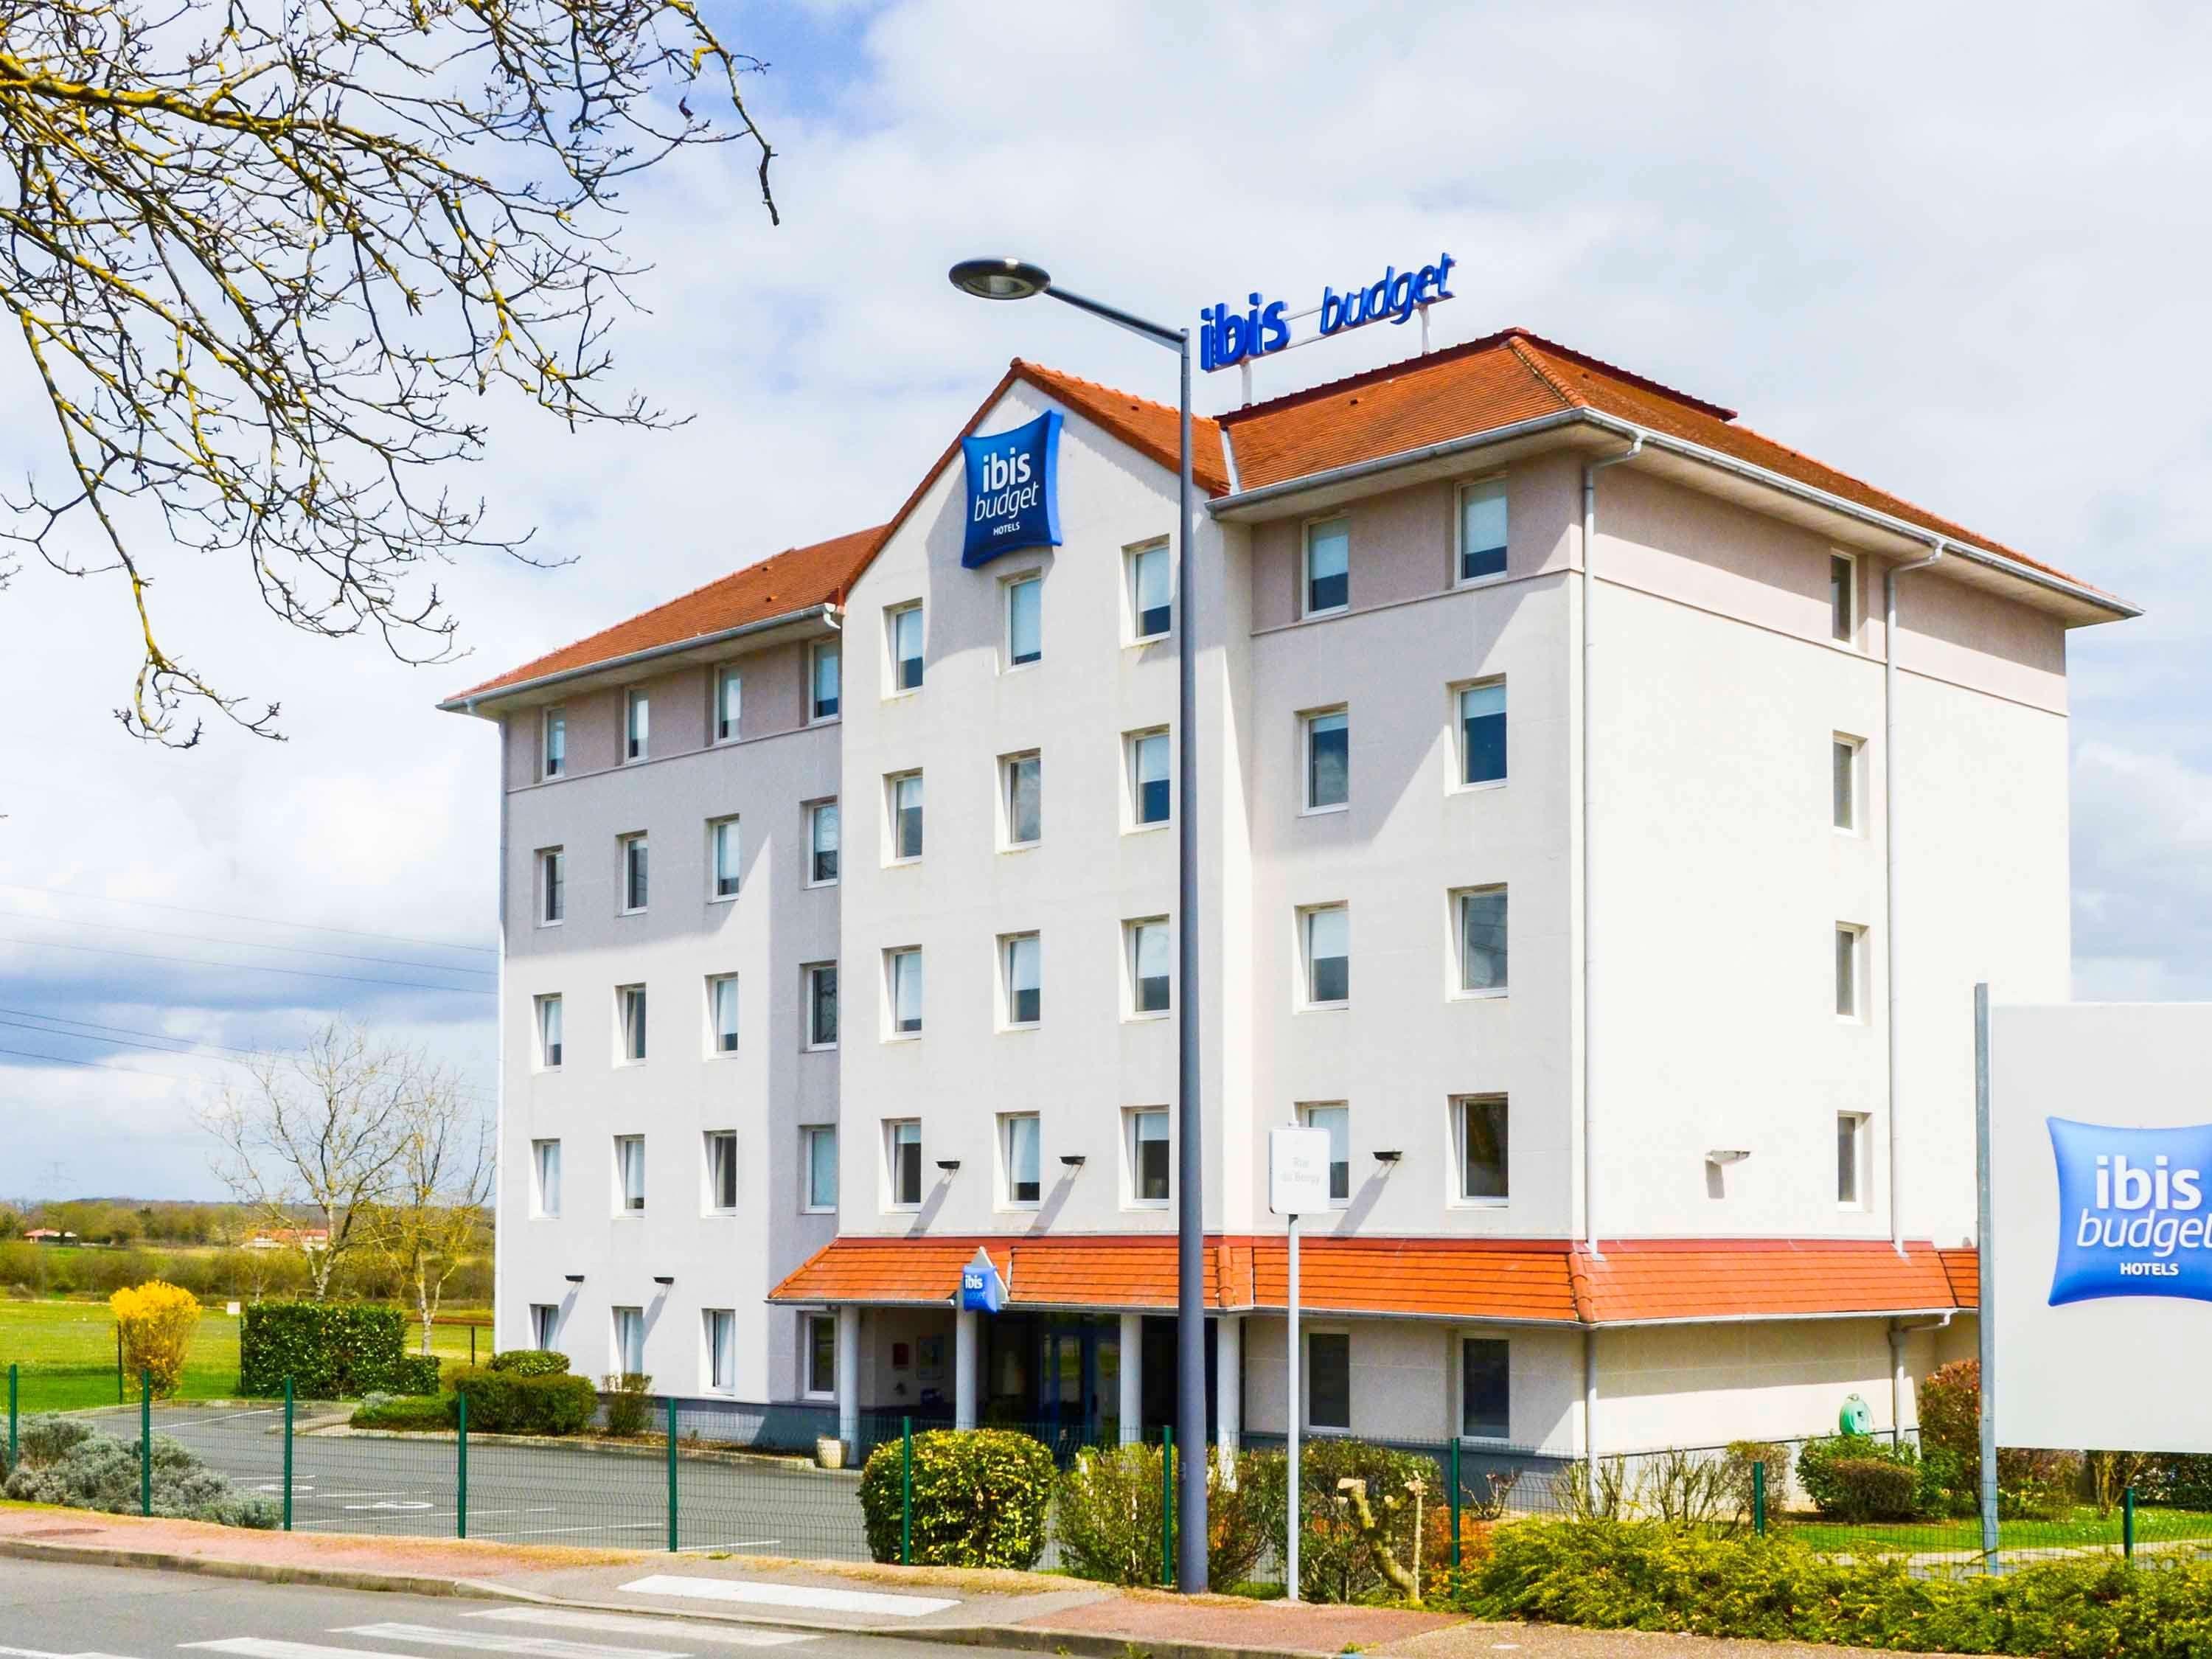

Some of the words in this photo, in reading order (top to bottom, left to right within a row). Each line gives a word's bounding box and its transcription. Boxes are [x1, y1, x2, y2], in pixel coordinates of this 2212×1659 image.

[1200, 292, 1290, 372] ibis
[1320, 252, 1456, 335] budget
[983, 447, 1032, 493] ibis
[974, 481, 1039, 521] budget
[993, 522, 1020, 535] HOTELS
[2096, 1155, 2202, 1211] ibis
[964, 1274, 984, 1289] ibis
[2120, 1262, 2179, 1276] HOTELS
